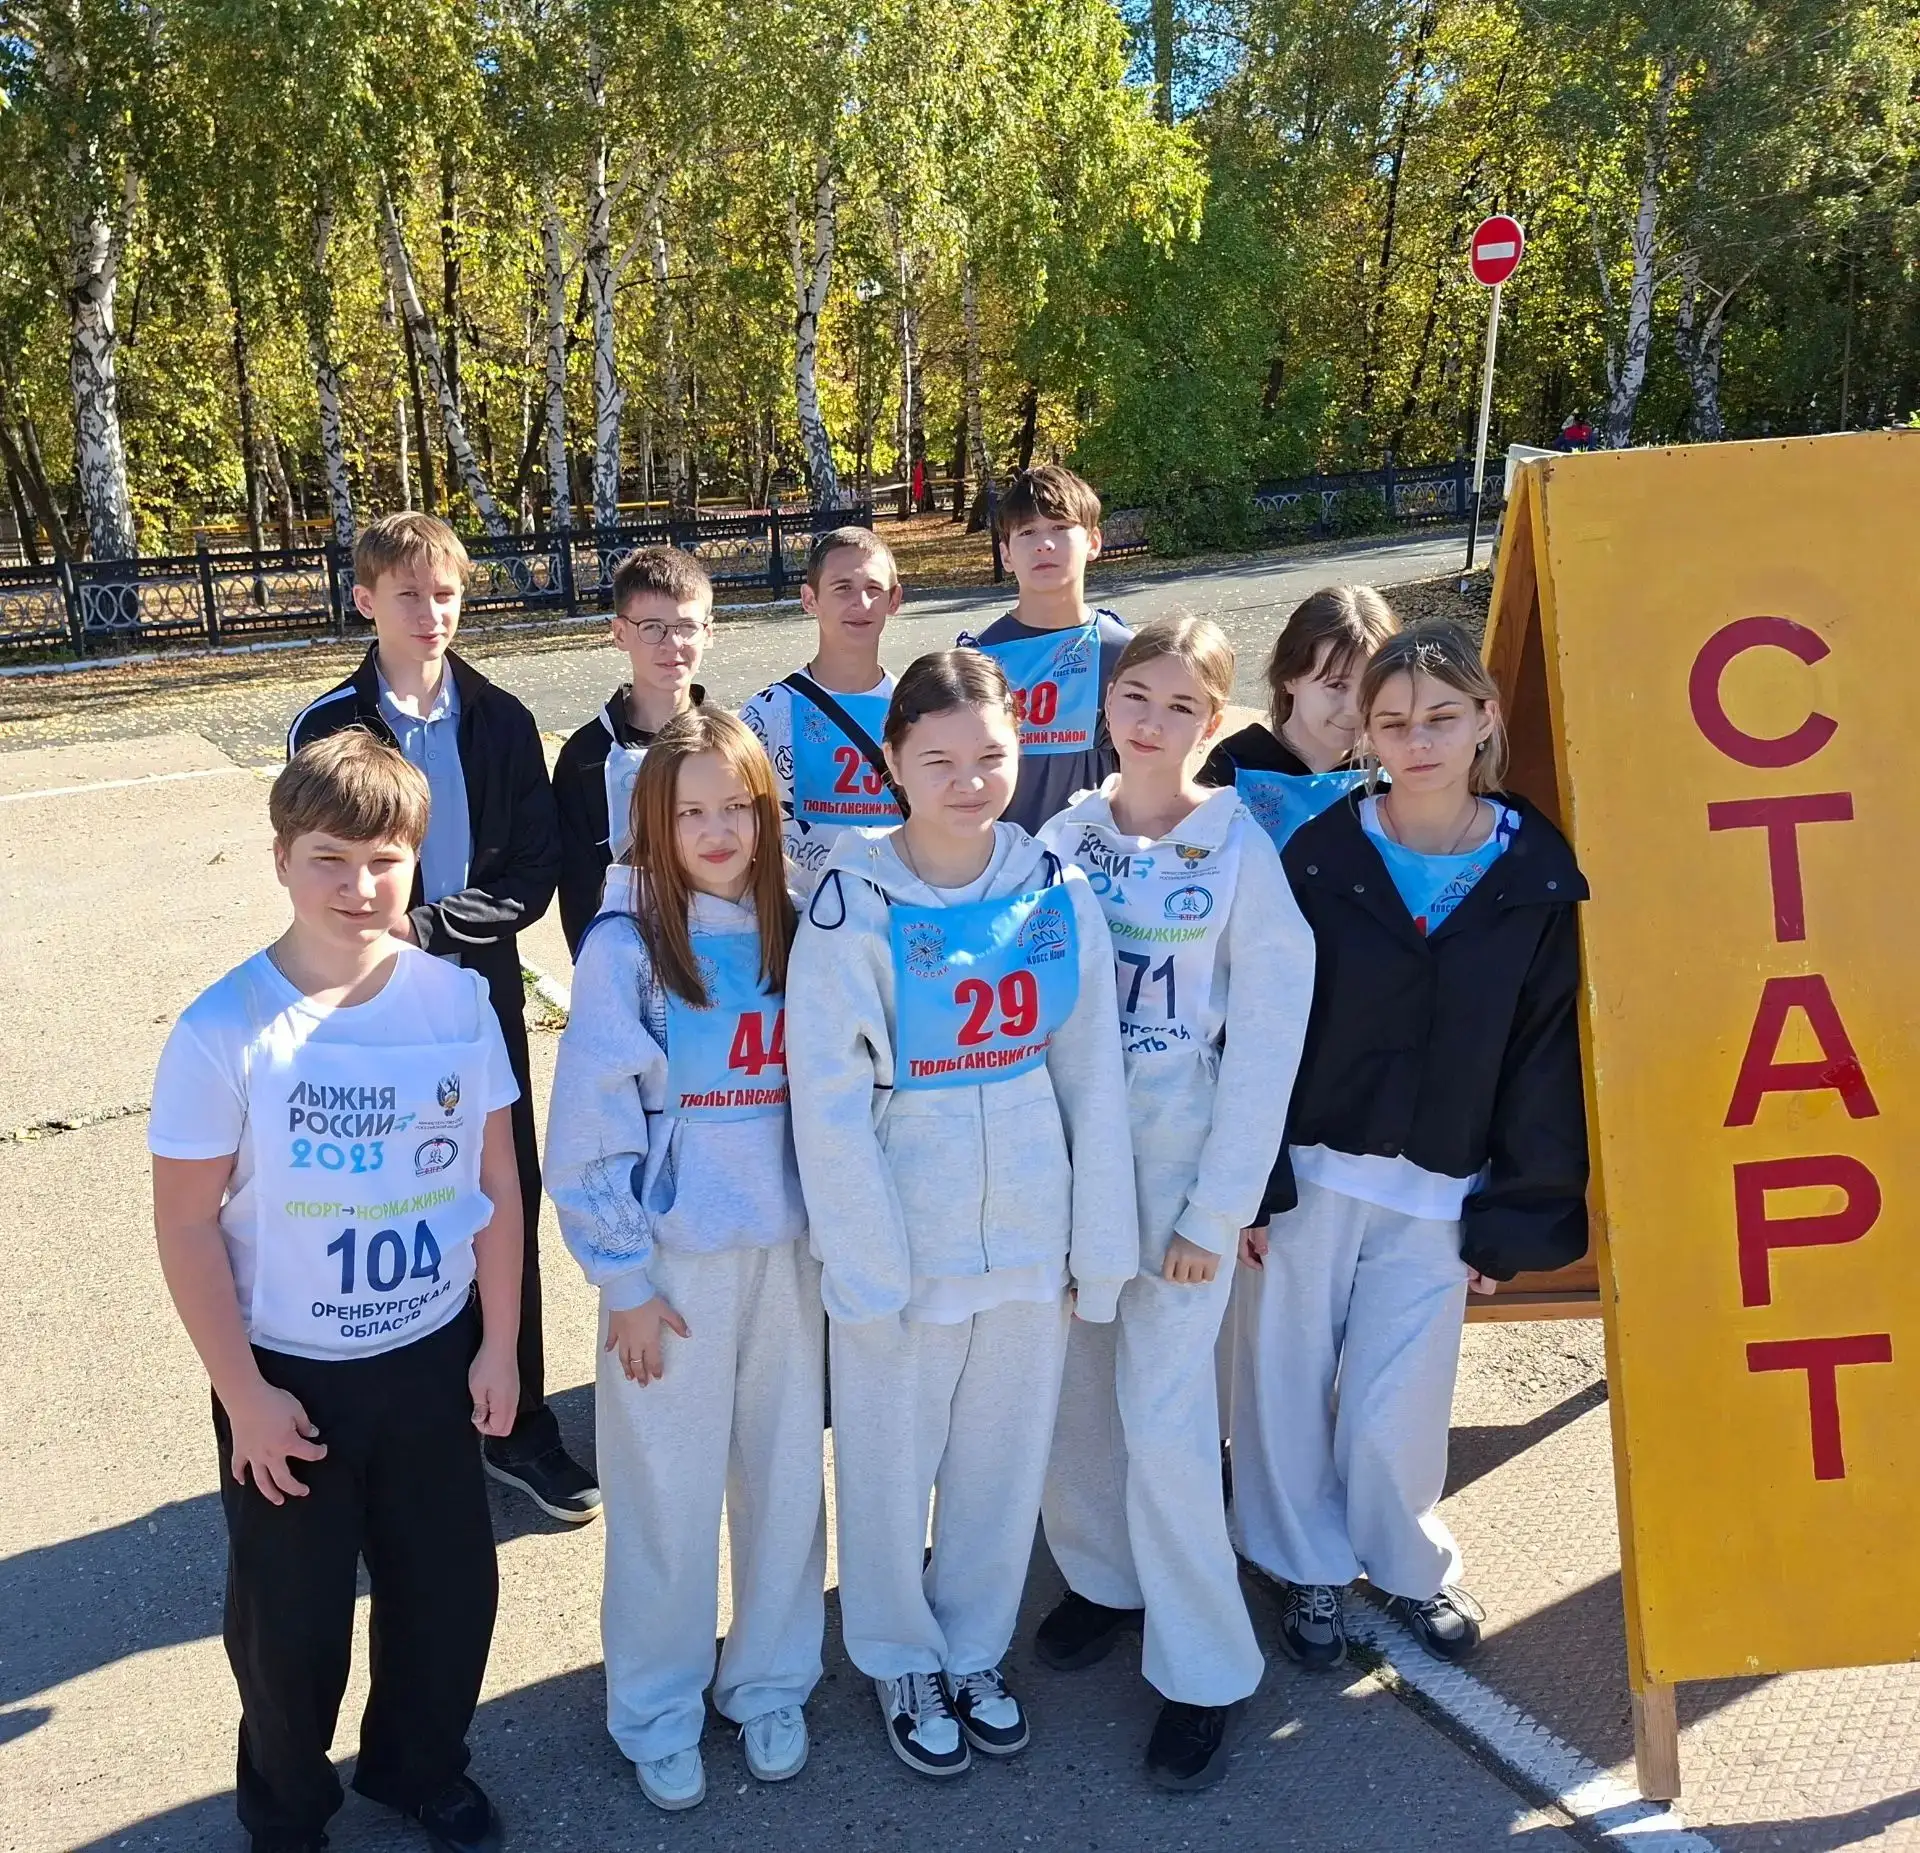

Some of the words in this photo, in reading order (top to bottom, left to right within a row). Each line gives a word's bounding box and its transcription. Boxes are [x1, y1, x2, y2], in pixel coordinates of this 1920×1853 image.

[1050, 728, 1087, 743] РАЙОН
[802, 799, 881, 815] ТЮЛЬГАНСКИЙ
[1152, 925, 1208, 943] ЖИЗНИ
[908, 964, 950, 978] РОССИИ
[1114, 949, 1176, 1020] 71
[954, 969, 1039, 1046] 29
[908, 1045, 1026, 1077] ТЮЛЬГАНСКИЙ
[1688, 614, 1893, 1481] СТАРТ
[286, 1080, 396, 1111] ЛЫЖНЯ
[289, 1107, 396, 1139] РОССИИ
[288, 1137, 385, 1174] 2023
[285, 1200, 342, 1219] СПОРТ
[356, 1200, 409, 1221] НОРМА
[409, 1186, 457, 1213] ЖИЗНИ
[327, 1219, 442, 1295] 104
[311, 1280, 452, 1321] ОРЕНБУРГСКАЯ
[340, 1309, 422, 1338] ОБЛАСТЬ
